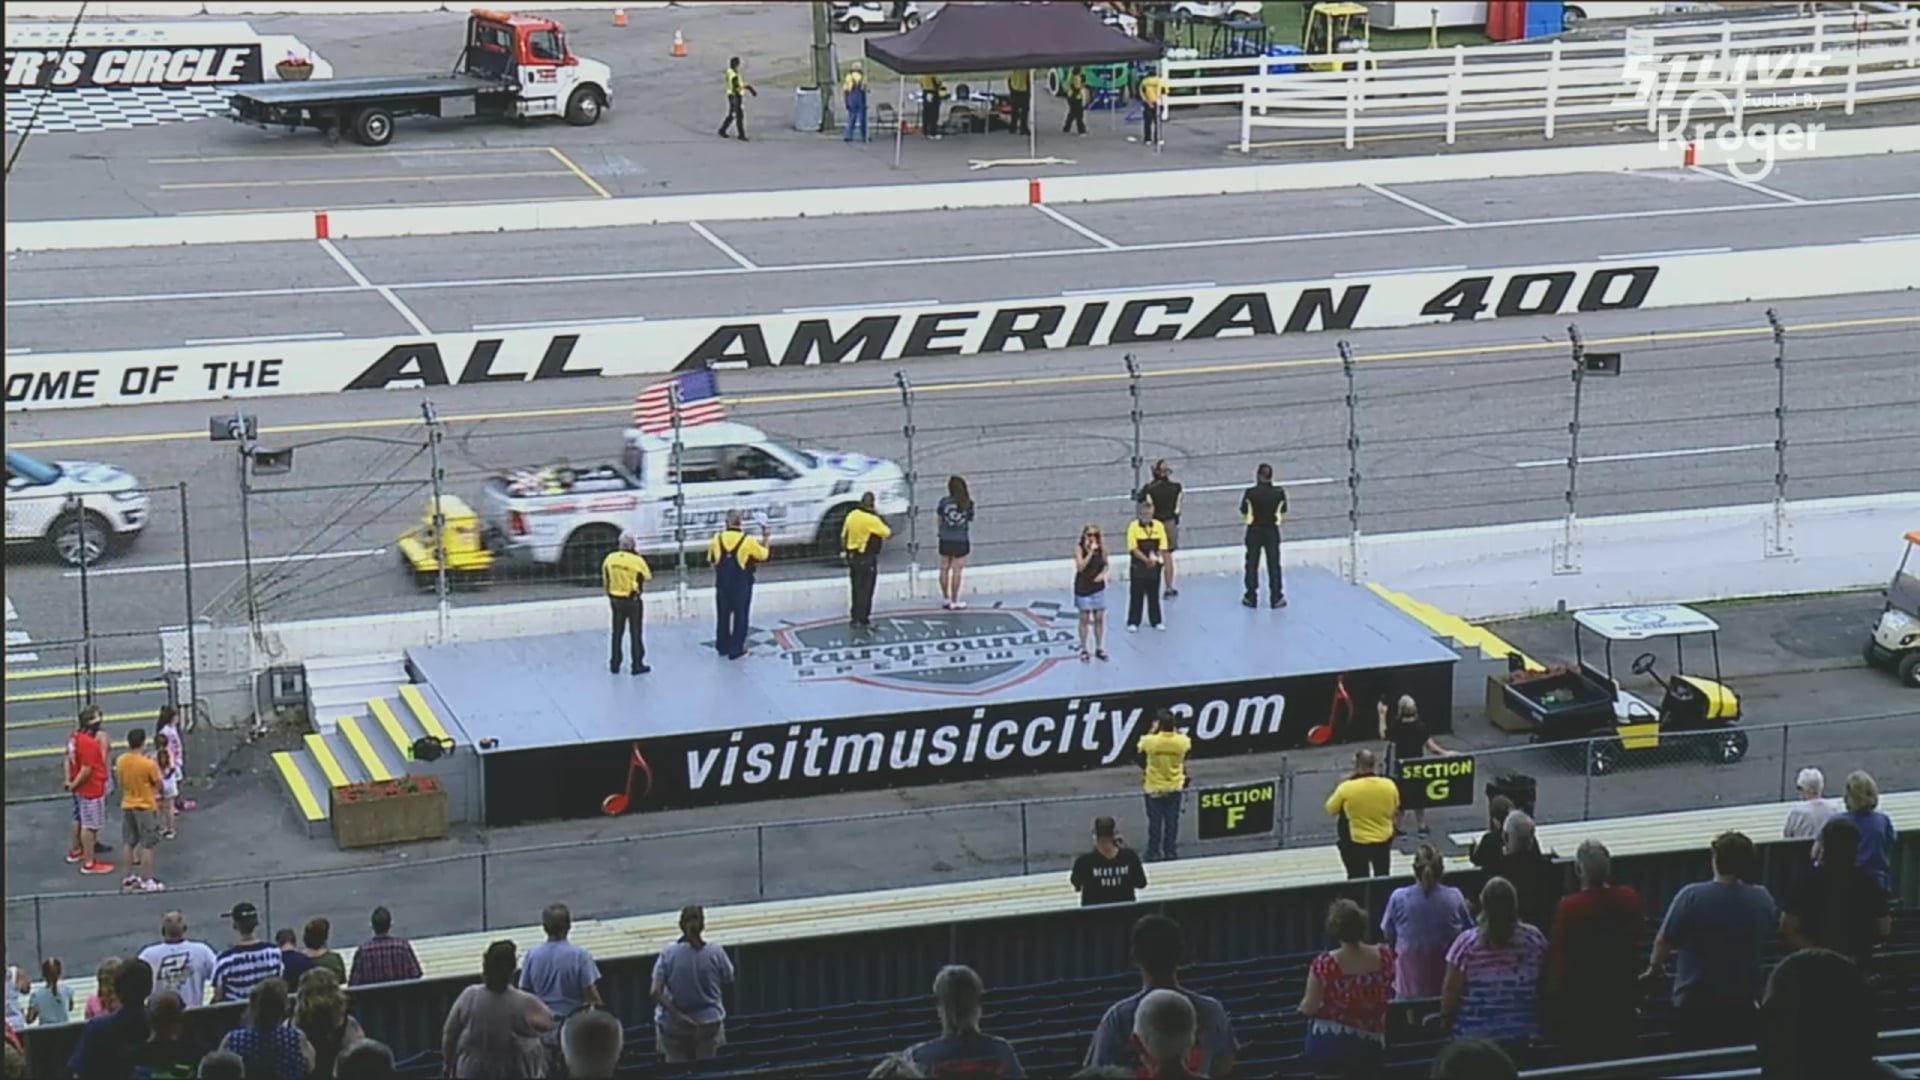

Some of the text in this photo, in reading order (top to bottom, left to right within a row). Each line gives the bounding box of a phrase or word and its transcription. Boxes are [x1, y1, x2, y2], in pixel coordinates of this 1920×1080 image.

[92, 48, 250, 84] CIRCLE
[120, 365, 178, 396] OF
[203, 359, 283, 390] THE
[341, 334, 603, 391] ALL
[672, 284, 1371, 371] AMERICAN
[1420, 266, 1659, 321] 400
[686, 693, 1286, 790] visitmusiccitycom
[1401, 760, 1473, 779] SECTION
[1201, 786, 1273, 808] SECTION
[1426, 779, 1450, 800] G
[1226, 805, 1246, 829] F
